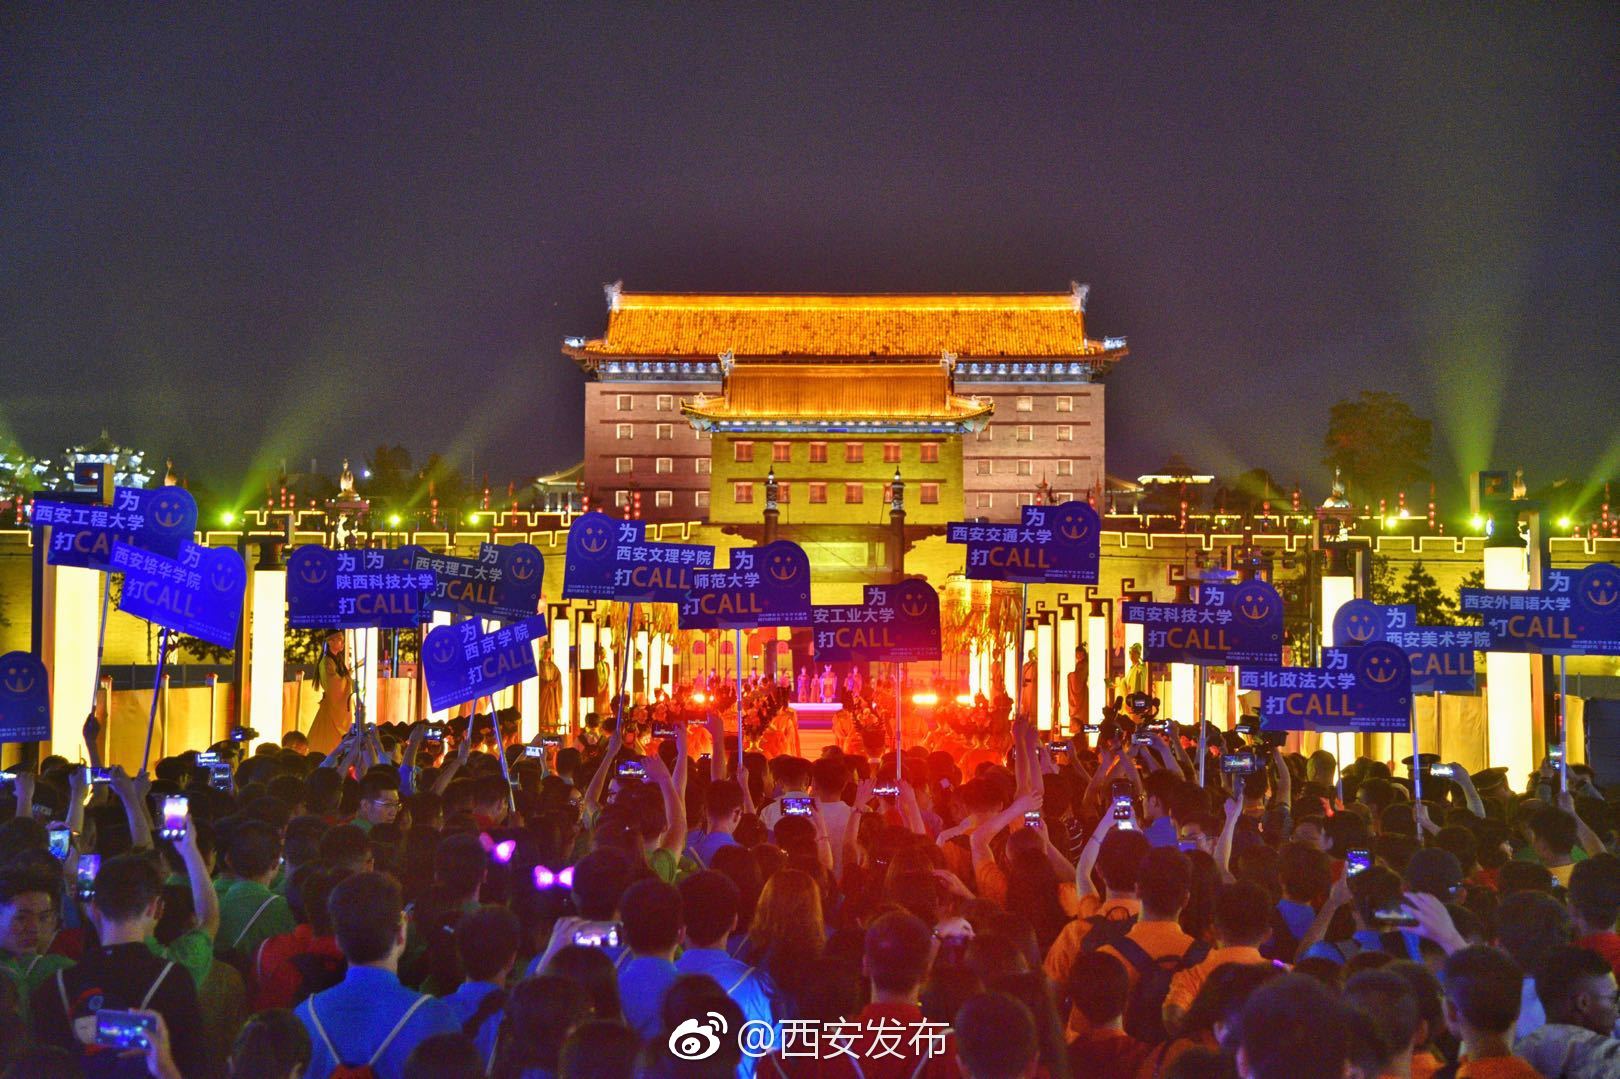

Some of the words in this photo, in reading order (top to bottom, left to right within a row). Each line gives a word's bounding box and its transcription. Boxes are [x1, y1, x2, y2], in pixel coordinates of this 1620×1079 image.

[119, 491, 140, 512] 为
[36, 505, 144, 531] 西安工程大学
[1026, 509, 1045, 526] 为
[618, 524, 637, 543] 为
[952, 527, 1052, 544] 西安交通大学
[184, 545, 200, 568] 为
[337, 554, 355, 572] 为
[367, 552, 384, 569] 为
[482, 546, 498, 564] 为
[616, 546, 712, 565] 西安文理学院
[735, 551, 753, 570] 为
[971, 546, 1050, 568] 打CALL
[114, 546, 201, 591] 西安培华学院
[416, 557, 502, 582] 西安理工大学
[615, 566, 690, 588] 打CALL
[336, 574, 433, 589] 陕西科技大学
[694, 572, 760, 589] 师范大学
[1549, 572, 1569, 592] 为
[126, 578, 195, 617] 打CALL
[339, 594, 416, 614] 打CALL
[868, 588, 886, 606] 为
[1205, 588, 1224, 607] 为
[1464, 595, 1571, 611] 西安外国语大学
[814, 608, 894, 623] 安工业大学
[1129, 606, 1232, 624] 西安科技大学
[1386, 608, 1406, 628] 为
[461, 624, 477, 643] 为
[464, 623, 529, 661] 西京学院
[818, 627, 895, 648] 打CALL
[1148, 628, 1231, 650] 打CALL
[1386, 631, 1491, 648] 西安美术学院
[467, 646, 535, 686] 打CALL
[1326, 650, 1347, 670] 为
[1241, 672, 1355, 689] 西北政法大学
[1266, 693, 1355, 716] 打CALL
